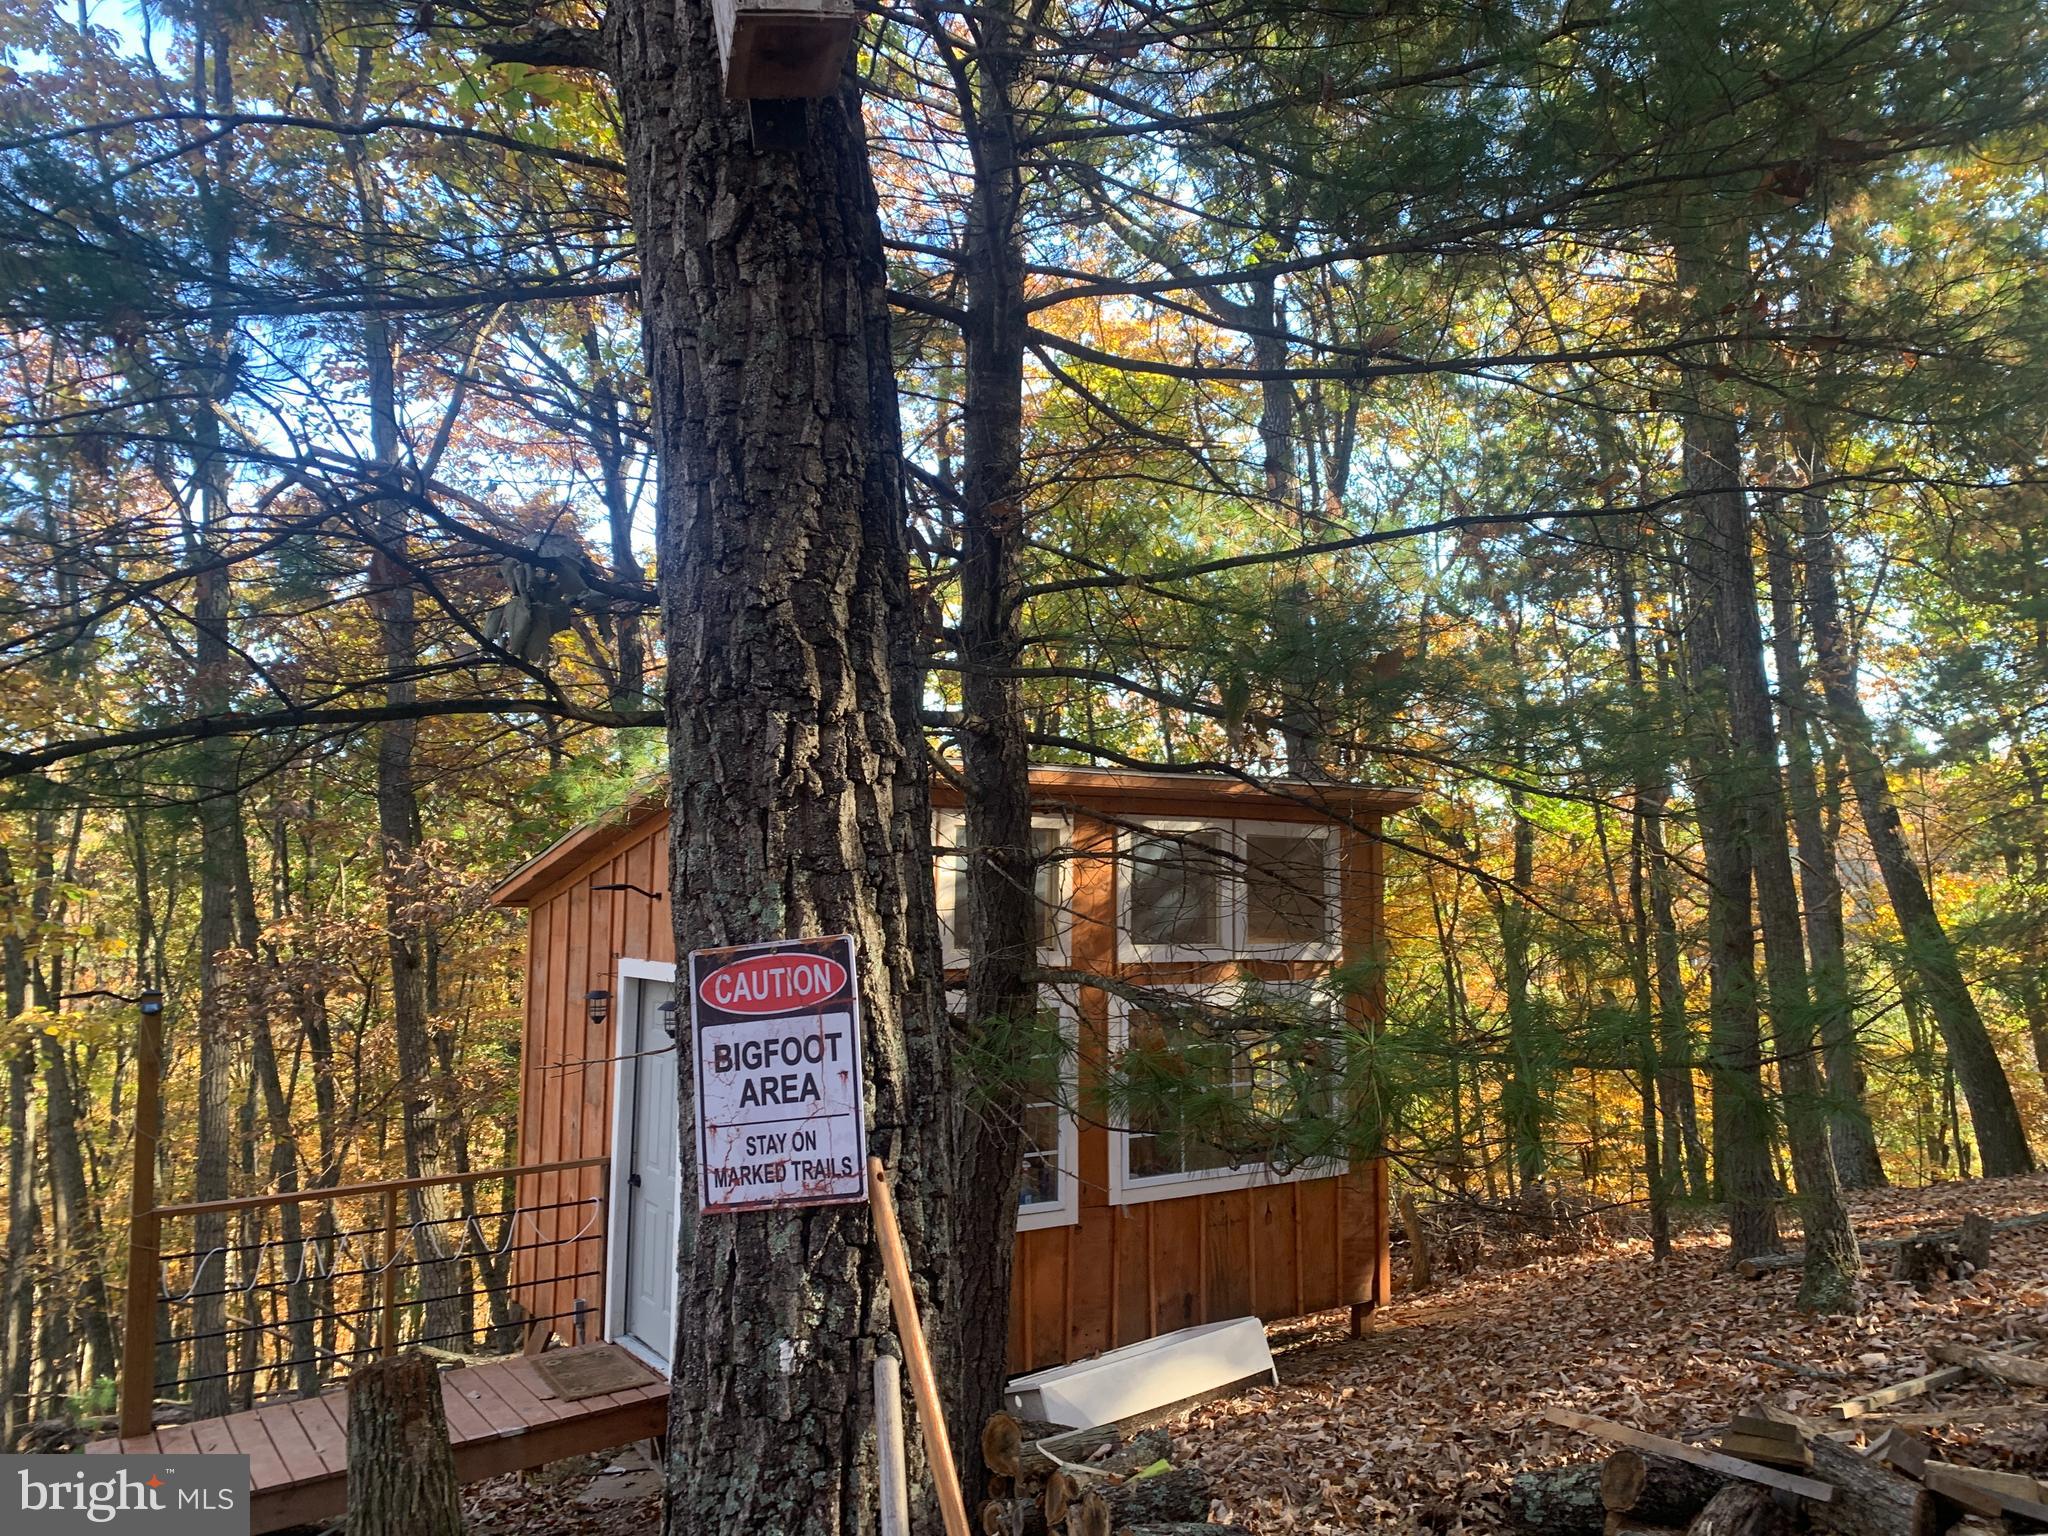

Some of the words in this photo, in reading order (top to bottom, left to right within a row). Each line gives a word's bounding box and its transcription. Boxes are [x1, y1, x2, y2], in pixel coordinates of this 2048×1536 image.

[715, 963, 832, 1004] CAUTION
[714, 1032, 842, 1073] BIGFOOT
[739, 1072, 821, 1108] AREA
[746, 1133, 787, 1156] STAY
[792, 1130, 817, 1152] ON
[714, 1162, 787, 1188] MARKED
[791, 1156, 853, 1182] TRAILS
